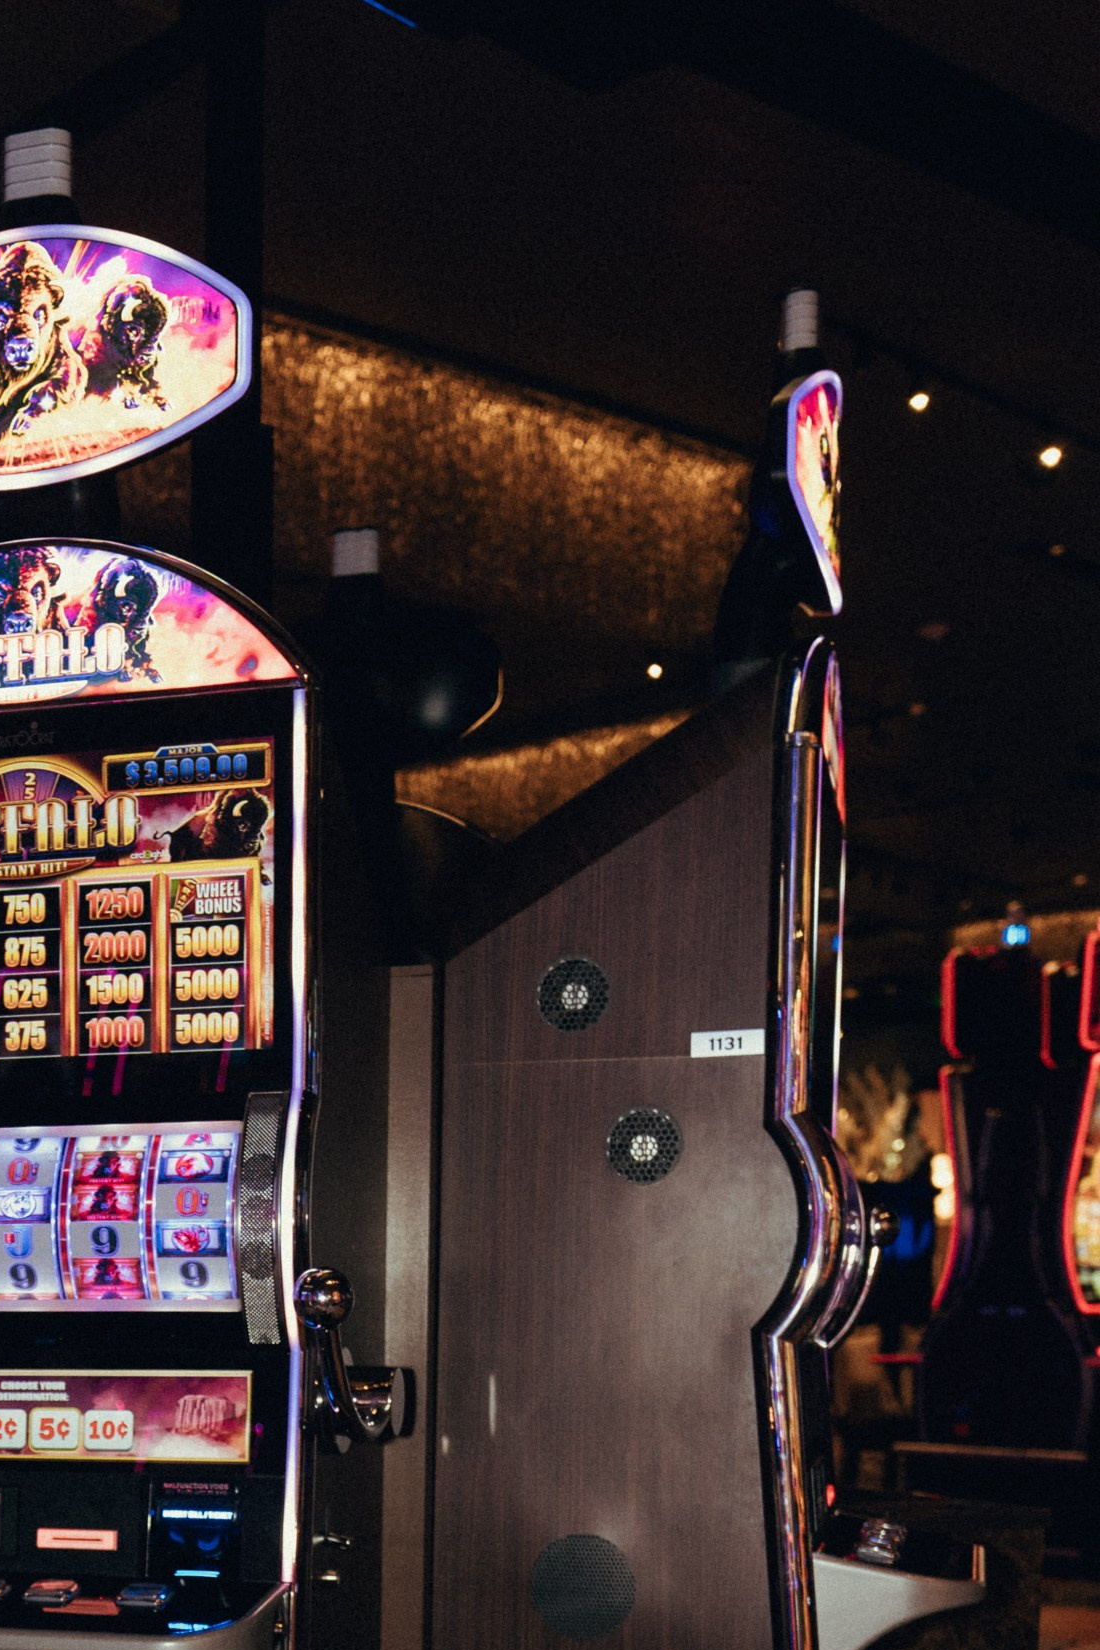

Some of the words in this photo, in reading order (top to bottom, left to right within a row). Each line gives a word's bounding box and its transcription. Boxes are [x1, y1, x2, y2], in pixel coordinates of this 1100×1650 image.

[168, 747, 202, 755] MAJOR
[40, 861, 68, 874] HIT!
[85, 887, 144, 920] 1250
[196, 881, 241, 898] WHEEL
[3, 893, 46, 924] 750
[195, 897, 242, 915] BONUS
[4, 936, 46, 968] 875
[84, 930, 146, 964] 2000
[176, 925, 239, 958] 5000
[3, 978, 48, 1009] 625
[86, 973, 144, 1005] 1500
[176, 968, 239, 1001] 5000
[5, 1020, 46, 1052] 375
[86, 1016, 145, 1048] 1000
[176, 1011, 239, 1045] 5000
[709, 1037, 742, 1051] 1131
[7, 1157, 39, 1186] Q
[175, 1186, 208, 1216] Q
[4, 1225, 33, 1259] J
[90, 1224, 119, 1257] 9
[9, 1262, 38, 1290] 9
[179, 1260, 209, 1289] 9
[39, 1418, 70, 1441] 5¢
[89, 1420, 128, 1440] 10¢
